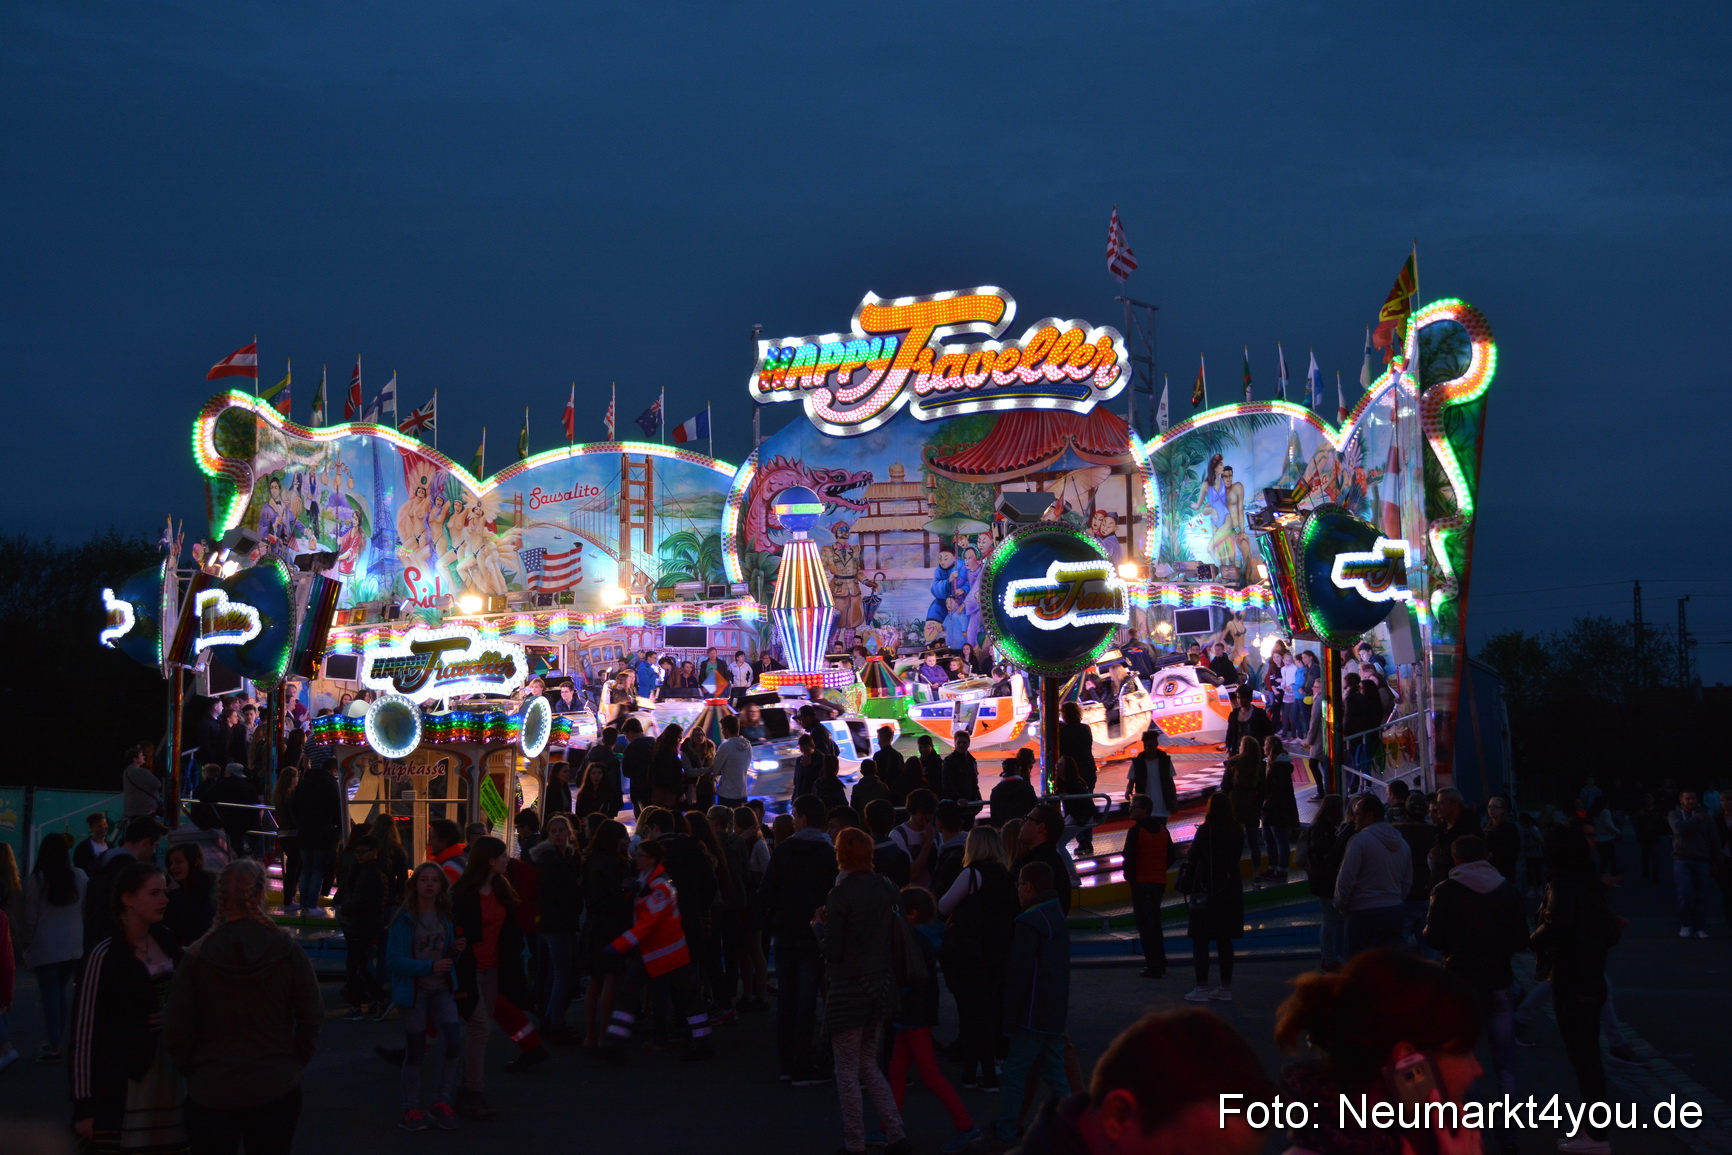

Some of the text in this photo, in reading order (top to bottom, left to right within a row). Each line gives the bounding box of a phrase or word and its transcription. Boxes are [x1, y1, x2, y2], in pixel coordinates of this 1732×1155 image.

[758, 294, 1121, 424] HAPPY Traveller
[529, 482, 600, 510] Sausalito
[392, 636, 518, 695] Traveller
[369, 759, 447, 782] Chipkasse
